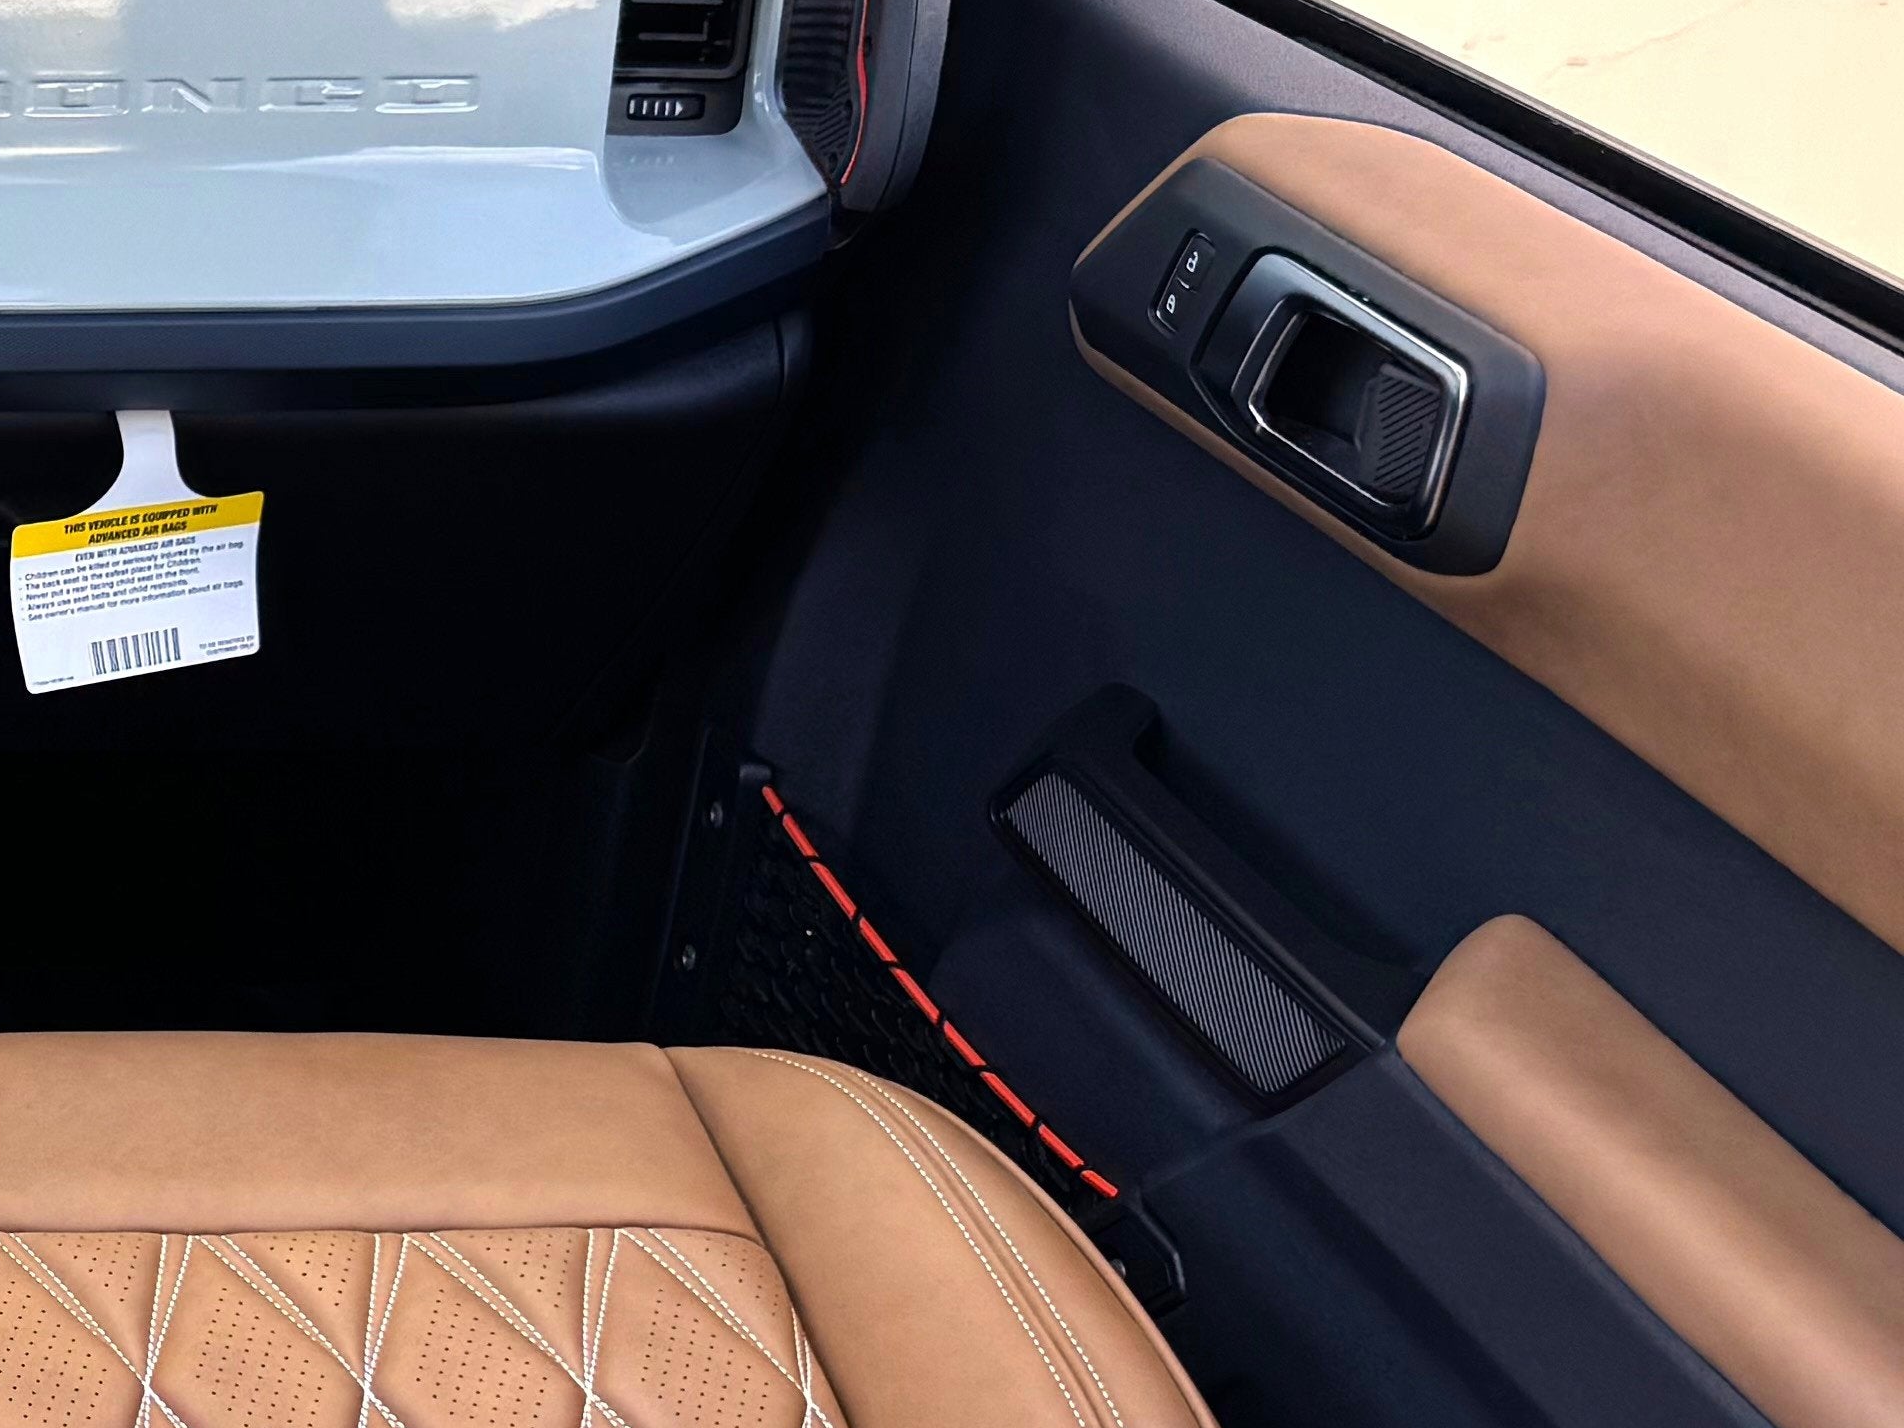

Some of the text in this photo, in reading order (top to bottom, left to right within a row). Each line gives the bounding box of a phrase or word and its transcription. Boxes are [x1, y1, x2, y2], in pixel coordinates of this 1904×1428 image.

[64, 522, 85, 534] THIS
[88, 527, 140, 545] ADVANCED
[161, 521, 188, 533] BAGS
